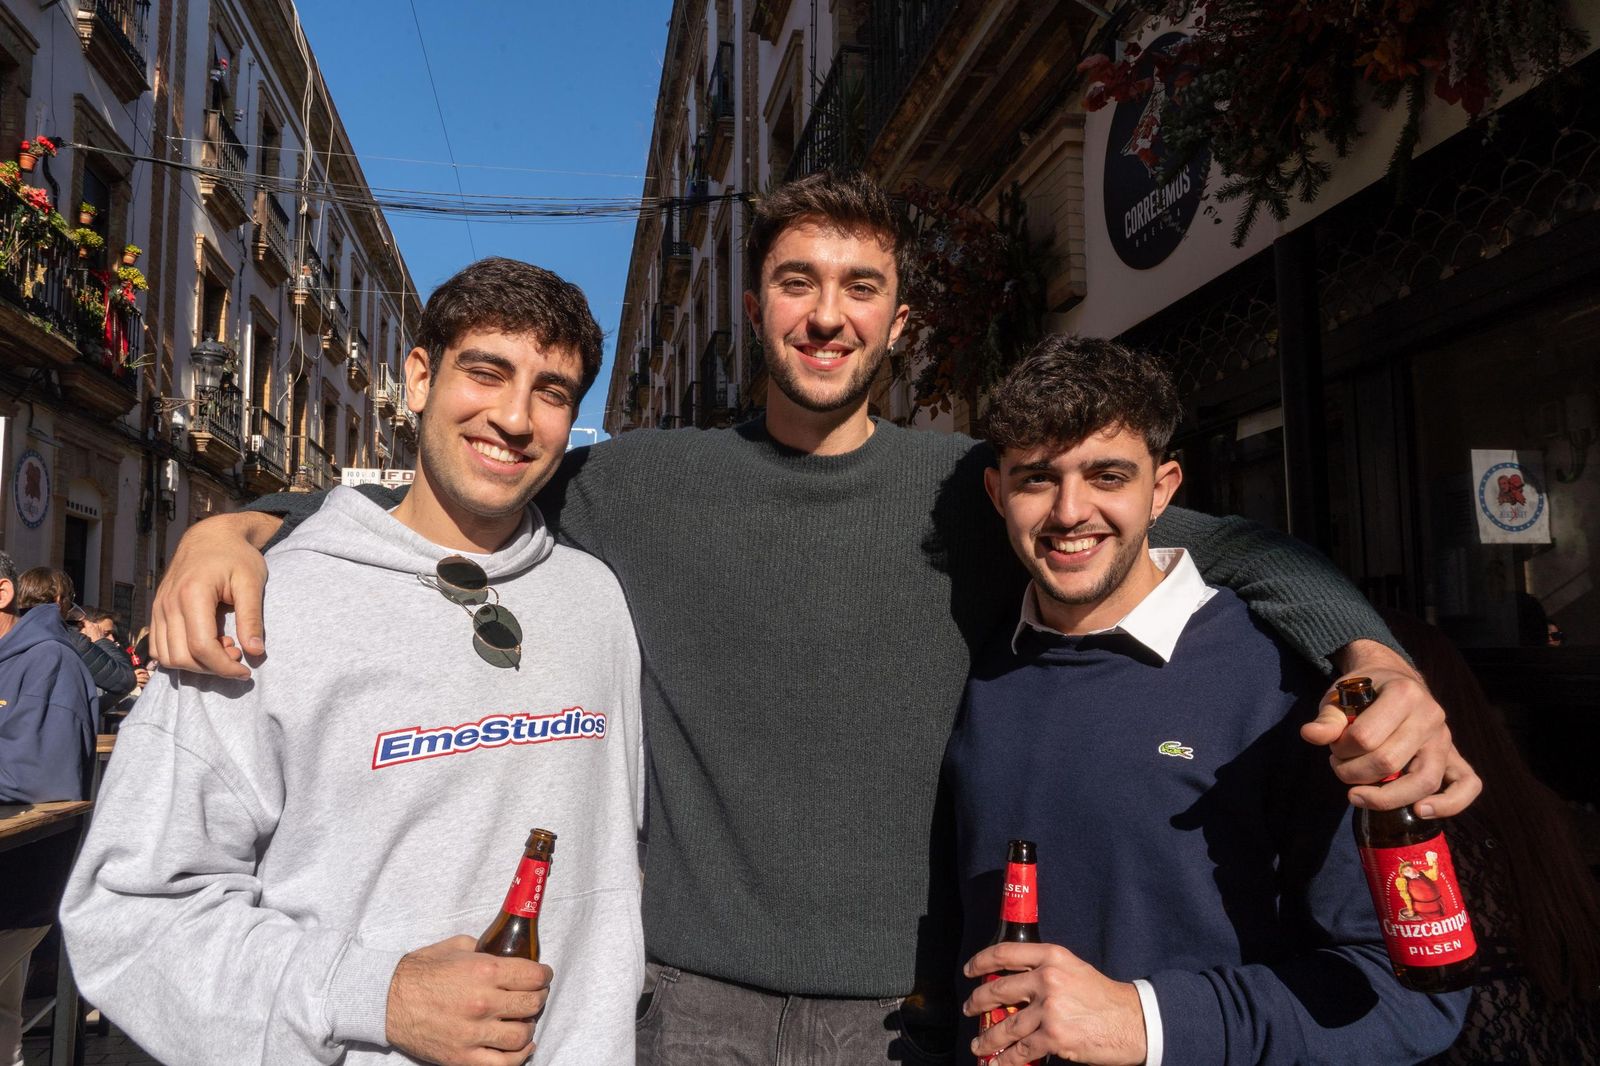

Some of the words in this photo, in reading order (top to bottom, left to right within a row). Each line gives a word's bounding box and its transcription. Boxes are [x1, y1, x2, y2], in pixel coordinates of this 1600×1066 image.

[378, 709, 606, 762] EmeStudios
[1383, 909, 1468, 938] Cruzcampo
[1409, 939, 1462, 956] PILSEN
